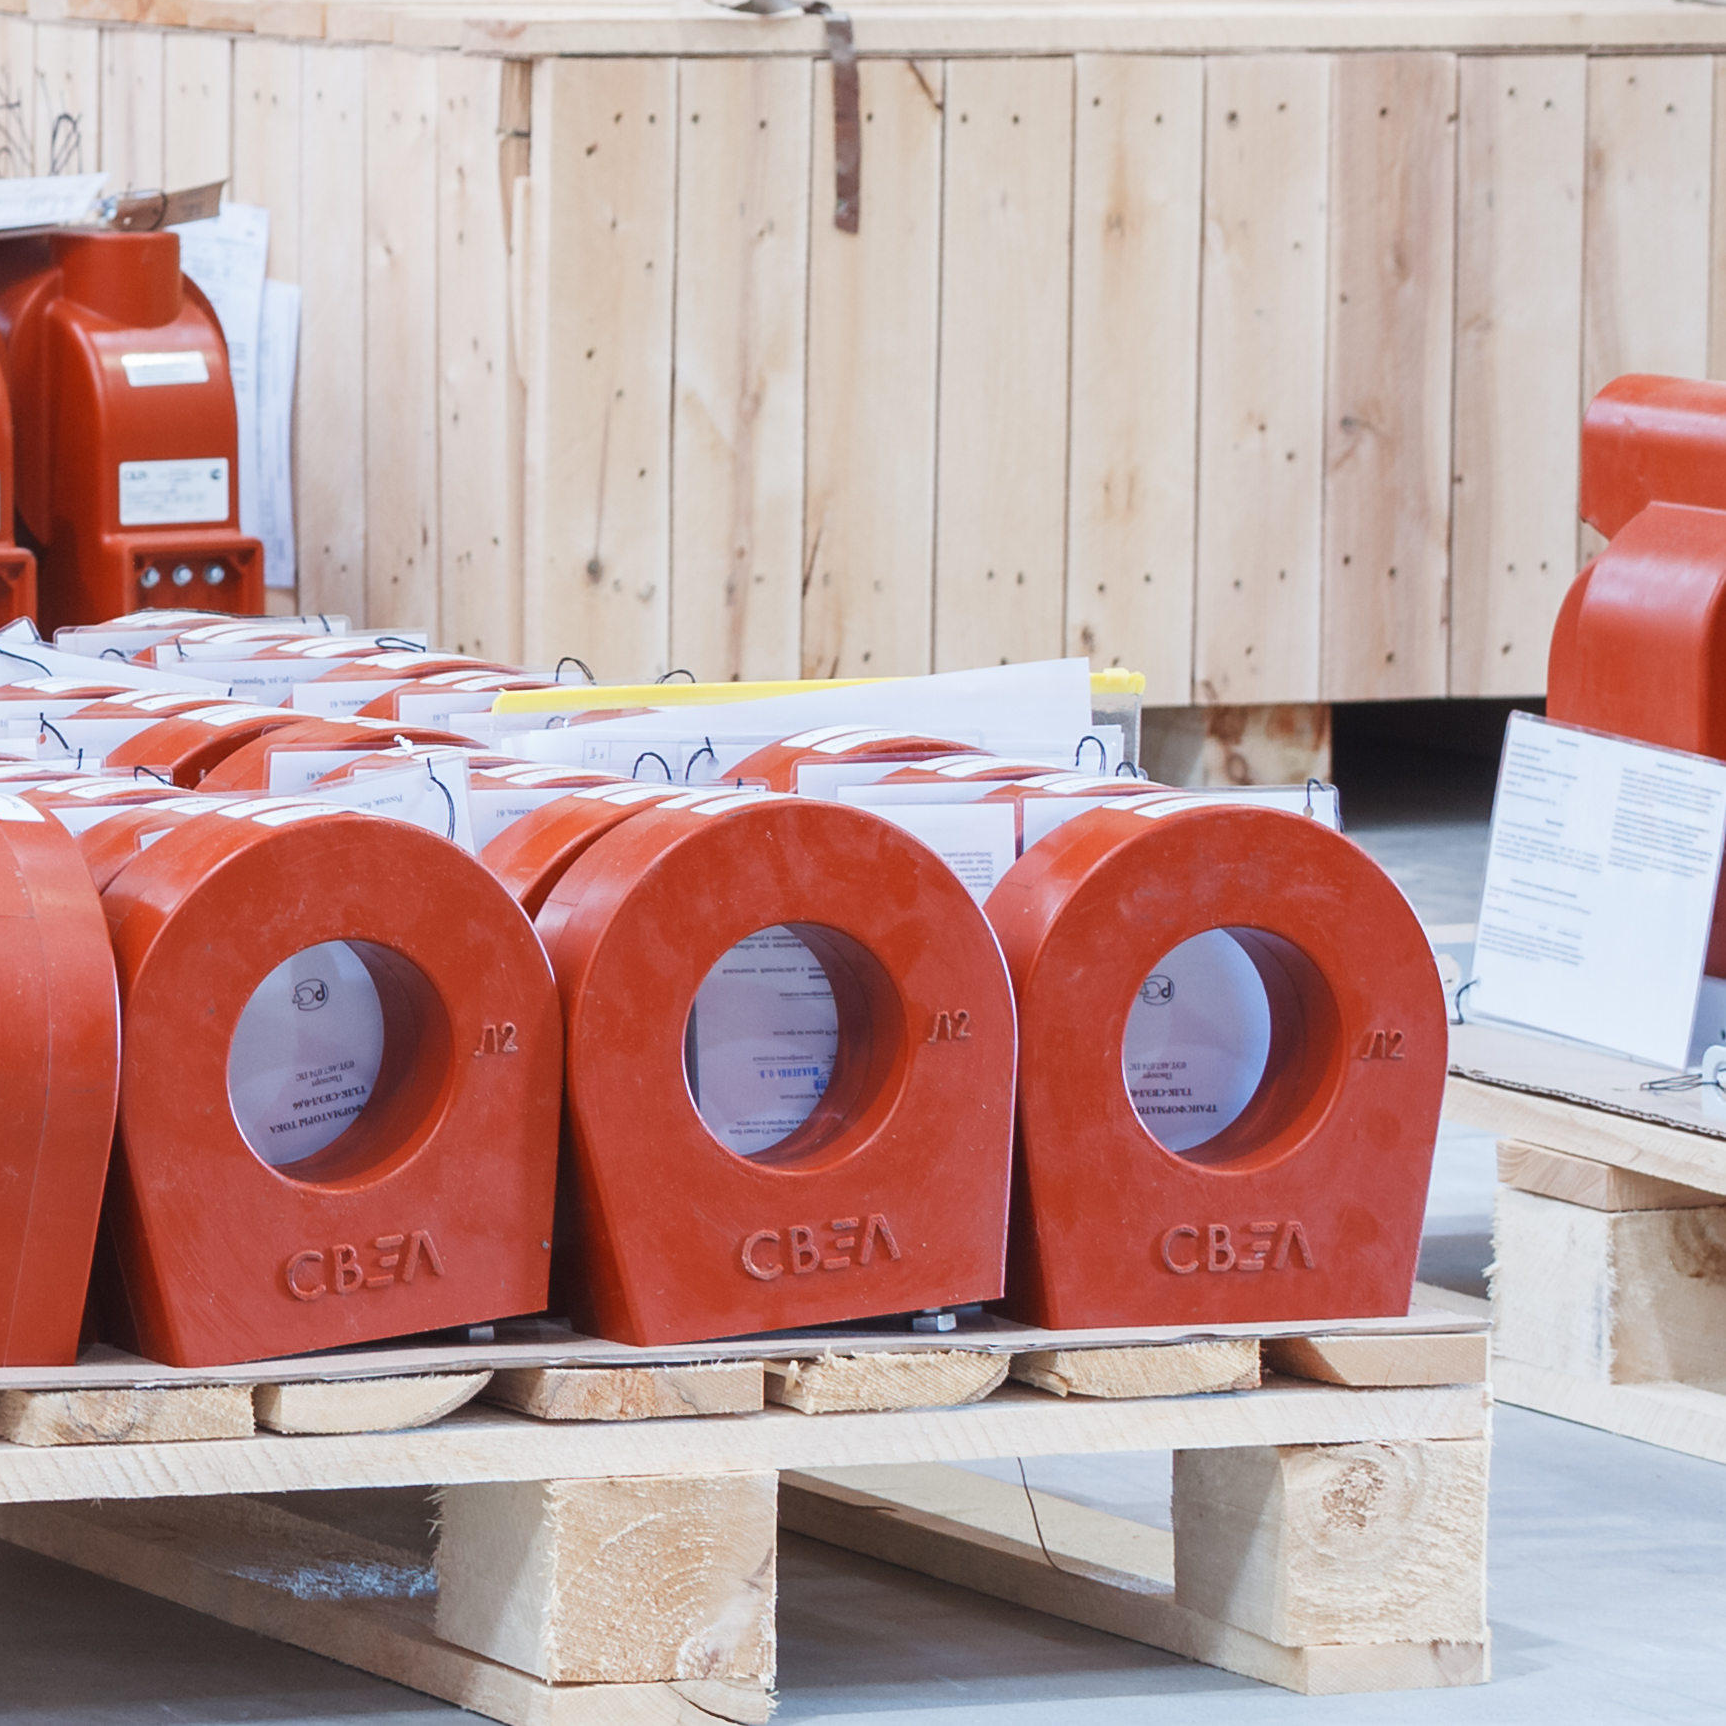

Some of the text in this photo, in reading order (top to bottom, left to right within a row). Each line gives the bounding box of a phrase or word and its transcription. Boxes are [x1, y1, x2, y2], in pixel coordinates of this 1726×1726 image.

[473, 1021, 520, 1059] Л2
[926, 1008, 973, 1044] Л2
[1360, 1029, 1408, 1062] Л2
[269, 1103, 364, 1134] ФОРМАТОРЫ ТОКА
